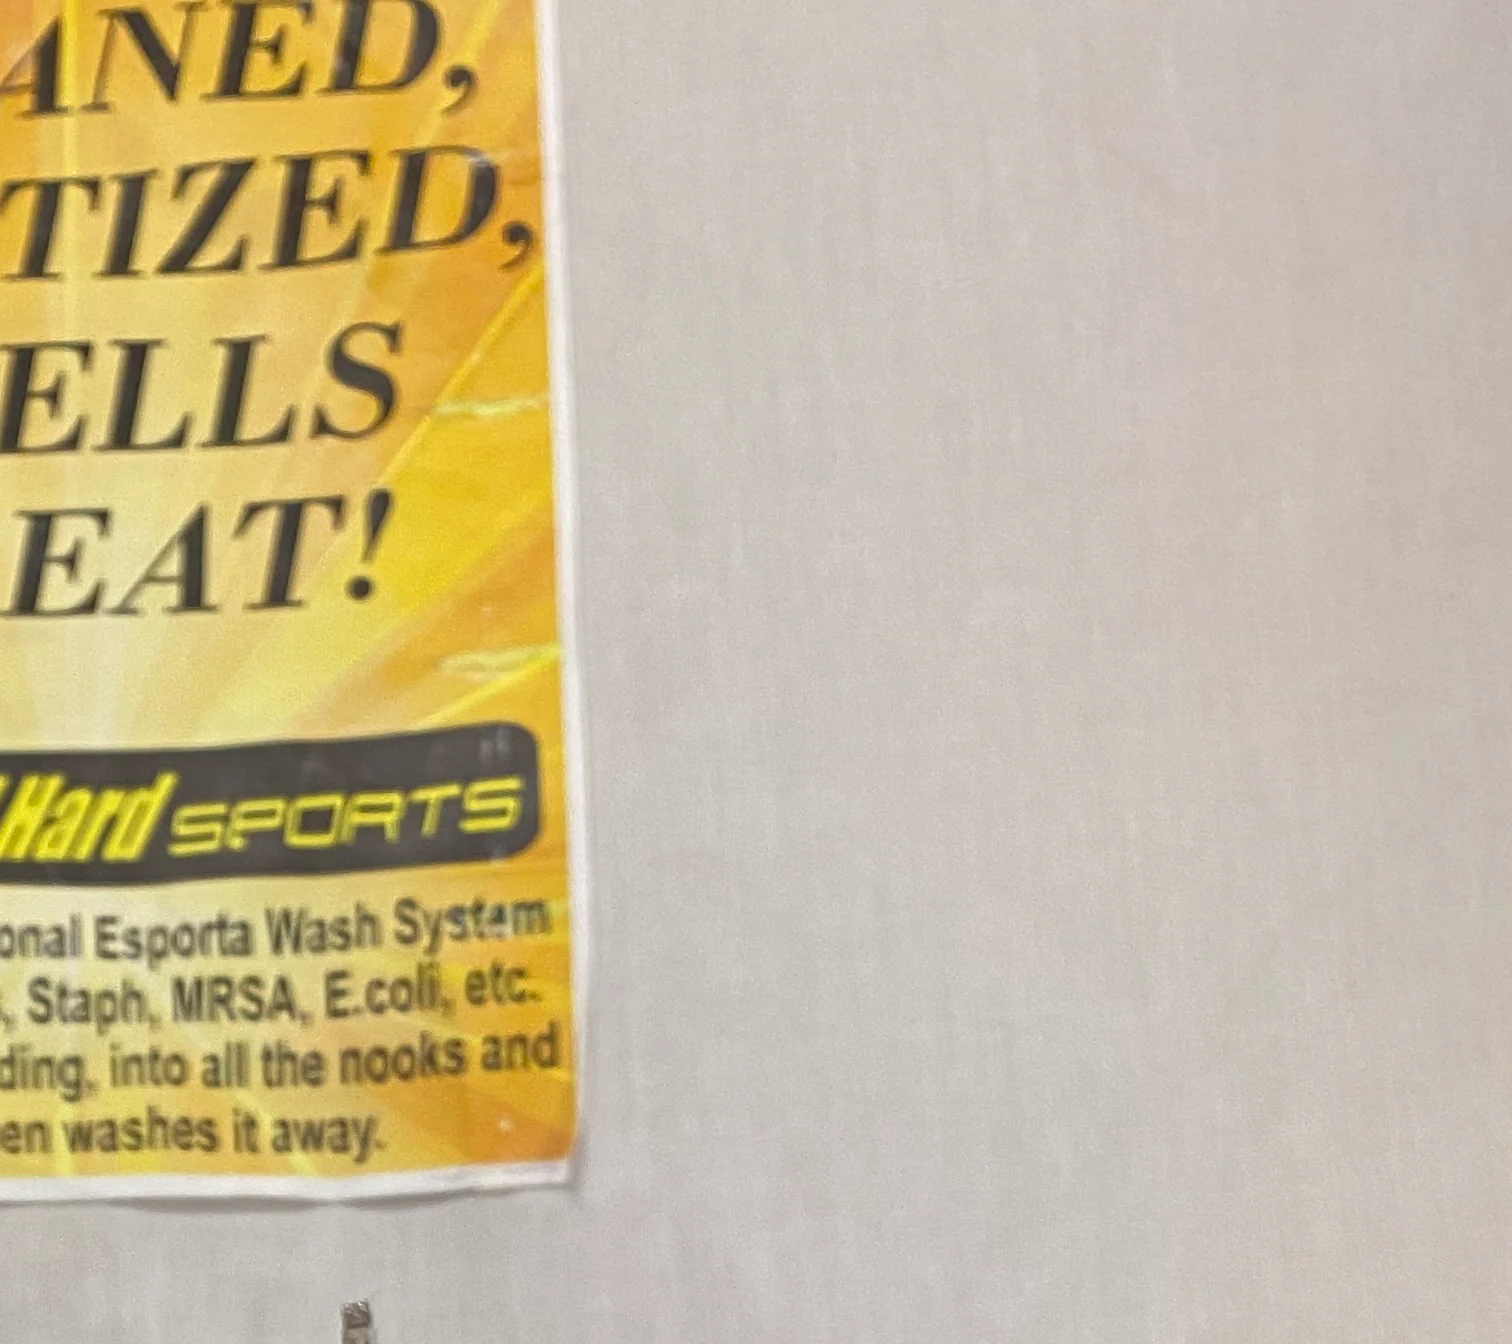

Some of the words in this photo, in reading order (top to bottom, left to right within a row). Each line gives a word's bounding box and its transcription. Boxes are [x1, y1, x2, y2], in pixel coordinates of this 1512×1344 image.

[168, 776, 522, 858] SPORTS
[94, 914, 253, 968] Esporta
[264, 903, 380, 955] Wash
[394, 897, 550, 953] System
[28, 975, 161, 1034] Staph,
[172, 973, 309, 1028] MRSA,
[323, 962, 455, 1020] E.coli,
[465, 960, 540, 1004] etc.
[109, 1041, 188, 1088] into
[201, 1039, 250, 1088] all
[261, 1040, 325, 1088] the
[338, 1030, 467, 1085] nooks
[481, 1021, 561, 1071] and
[62, 1104, 220, 1154] washes
[232, 1107, 260, 1153] it
[272, 1112, 388, 1165] away.
